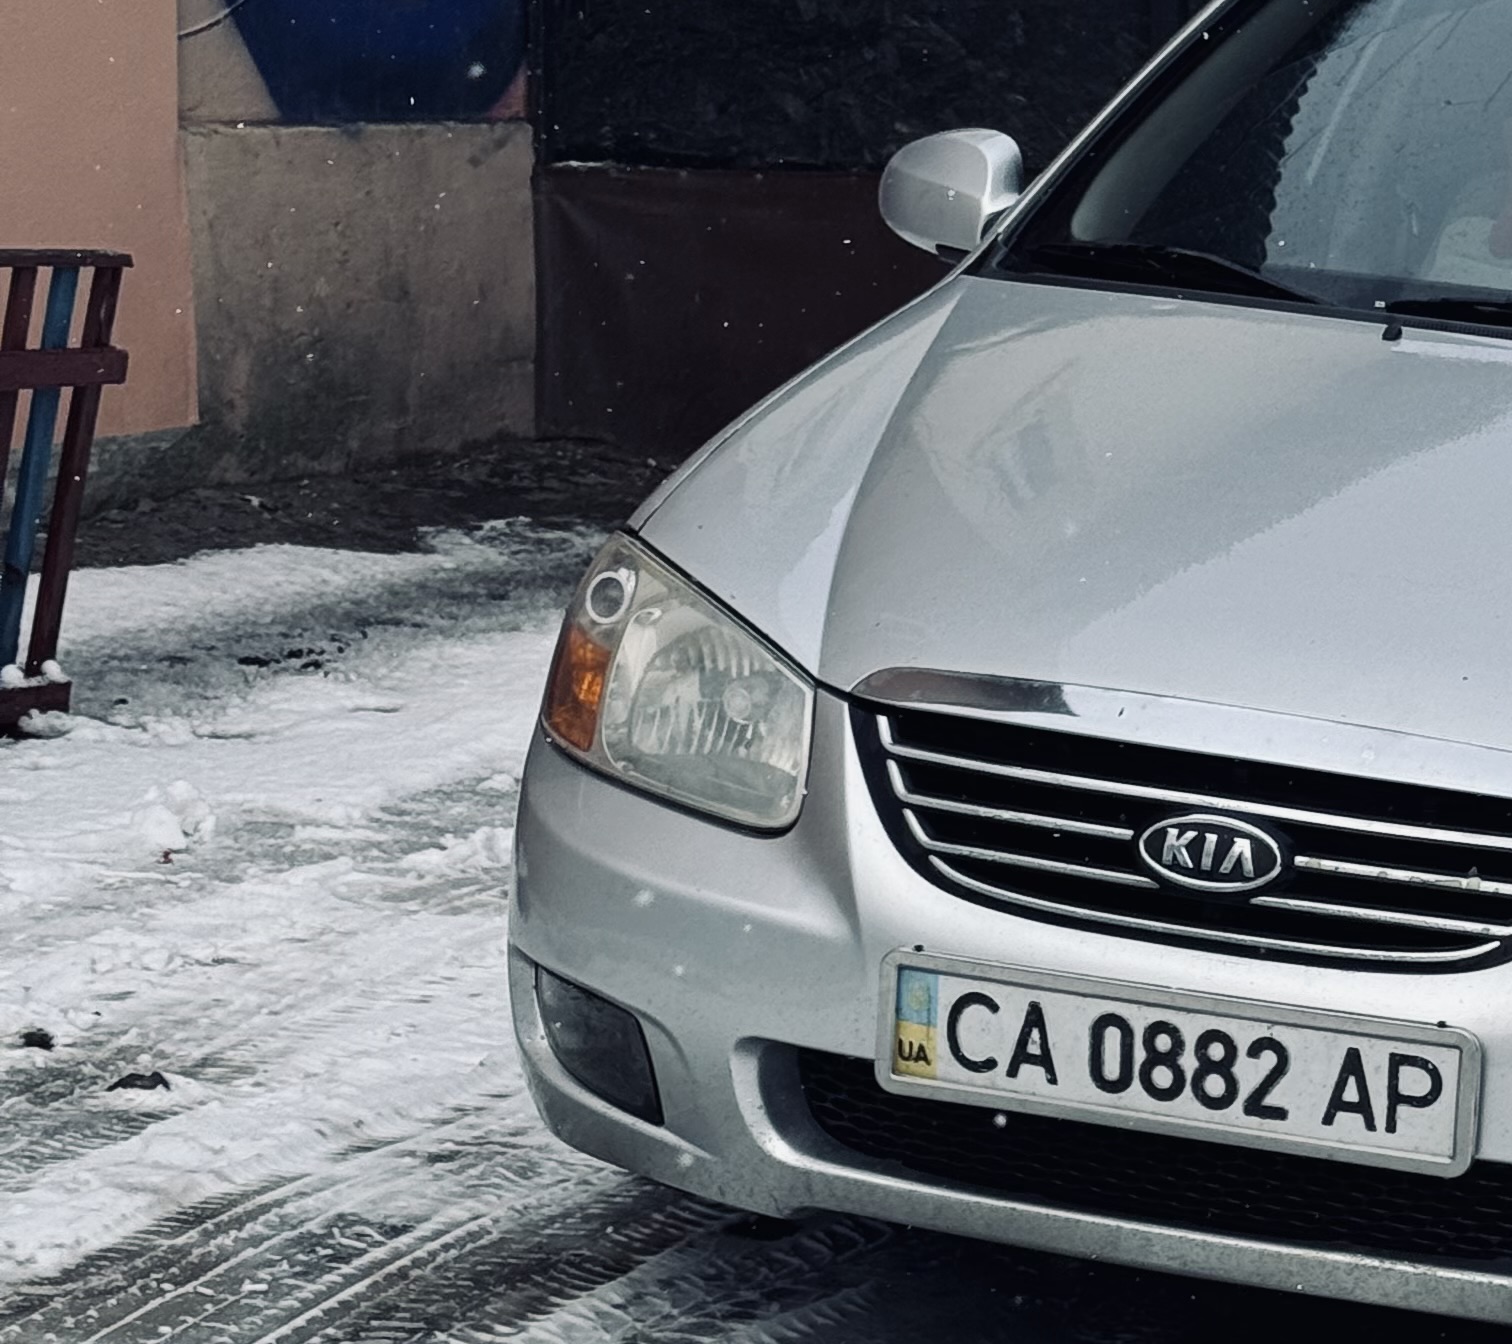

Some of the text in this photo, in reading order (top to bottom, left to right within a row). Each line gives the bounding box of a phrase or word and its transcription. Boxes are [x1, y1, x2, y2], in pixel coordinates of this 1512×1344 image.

[1161, 827, 1255, 878] KIA
[899, 1039, 931, 1067] UA
[946, 991, 1443, 1134] CA 0882 AP
